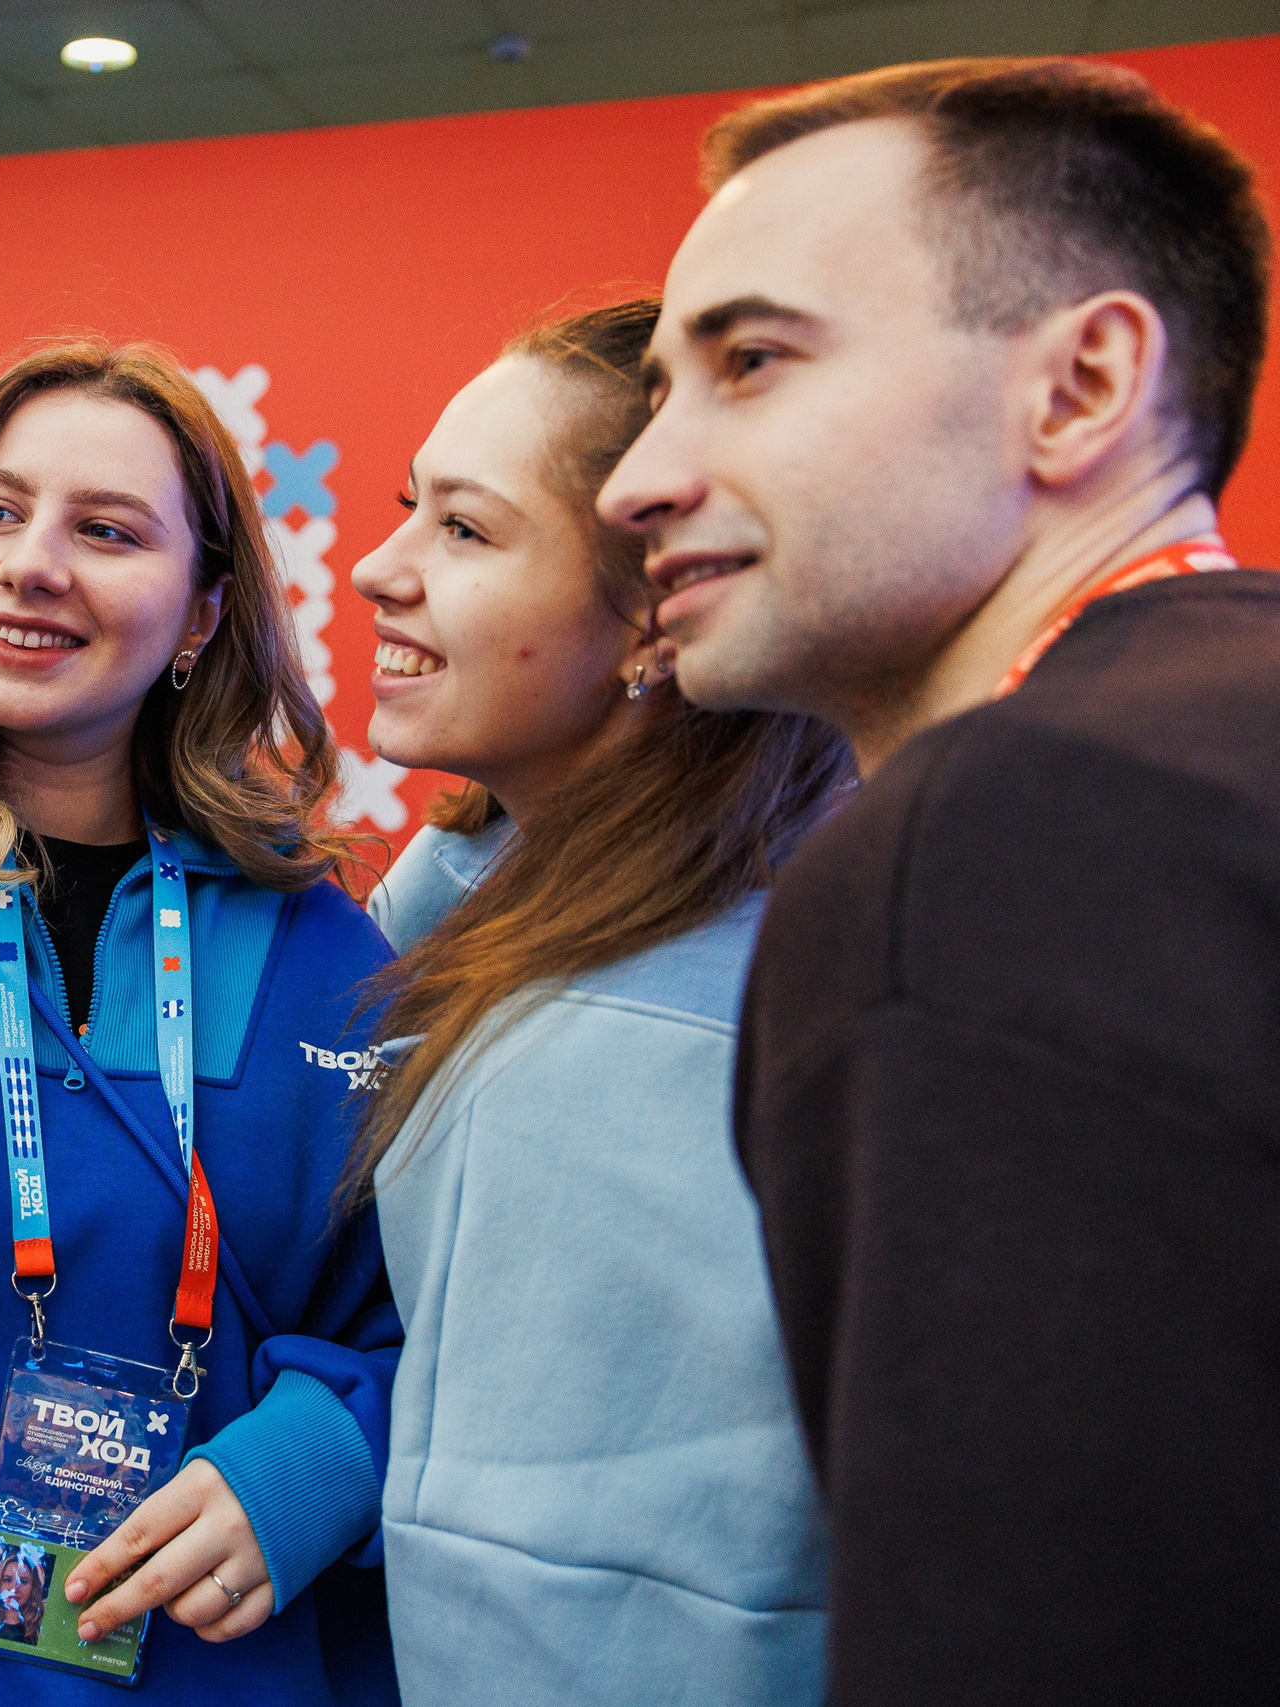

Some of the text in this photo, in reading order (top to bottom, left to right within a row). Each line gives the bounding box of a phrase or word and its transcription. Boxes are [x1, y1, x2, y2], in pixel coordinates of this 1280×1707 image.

[0, 983, 11, 1047] ВСЕРОССИЙСКИЙ
[8, 991, 18, 1047] СТУДЕНЧЕСКИЙ
[14, 1168, 31, 1220] ТВОЙ
[29, 1174, 44, 1216] ХОД
[188, 1231, 197, 1270] РОССИИ
[202, 1236, 211, 1273] СУДЬБУ,
[33, 1398, 126, 1440] ТВОЙ
[25, 1436, 47, 1445] ФОРУМ
[77, 1433, 151, 1471] ХОД
[45, 1476, 105, 1497] ЕДИНСТВО
[54, 1467, 123, 1490] ПОКОЛЕНИЙ
